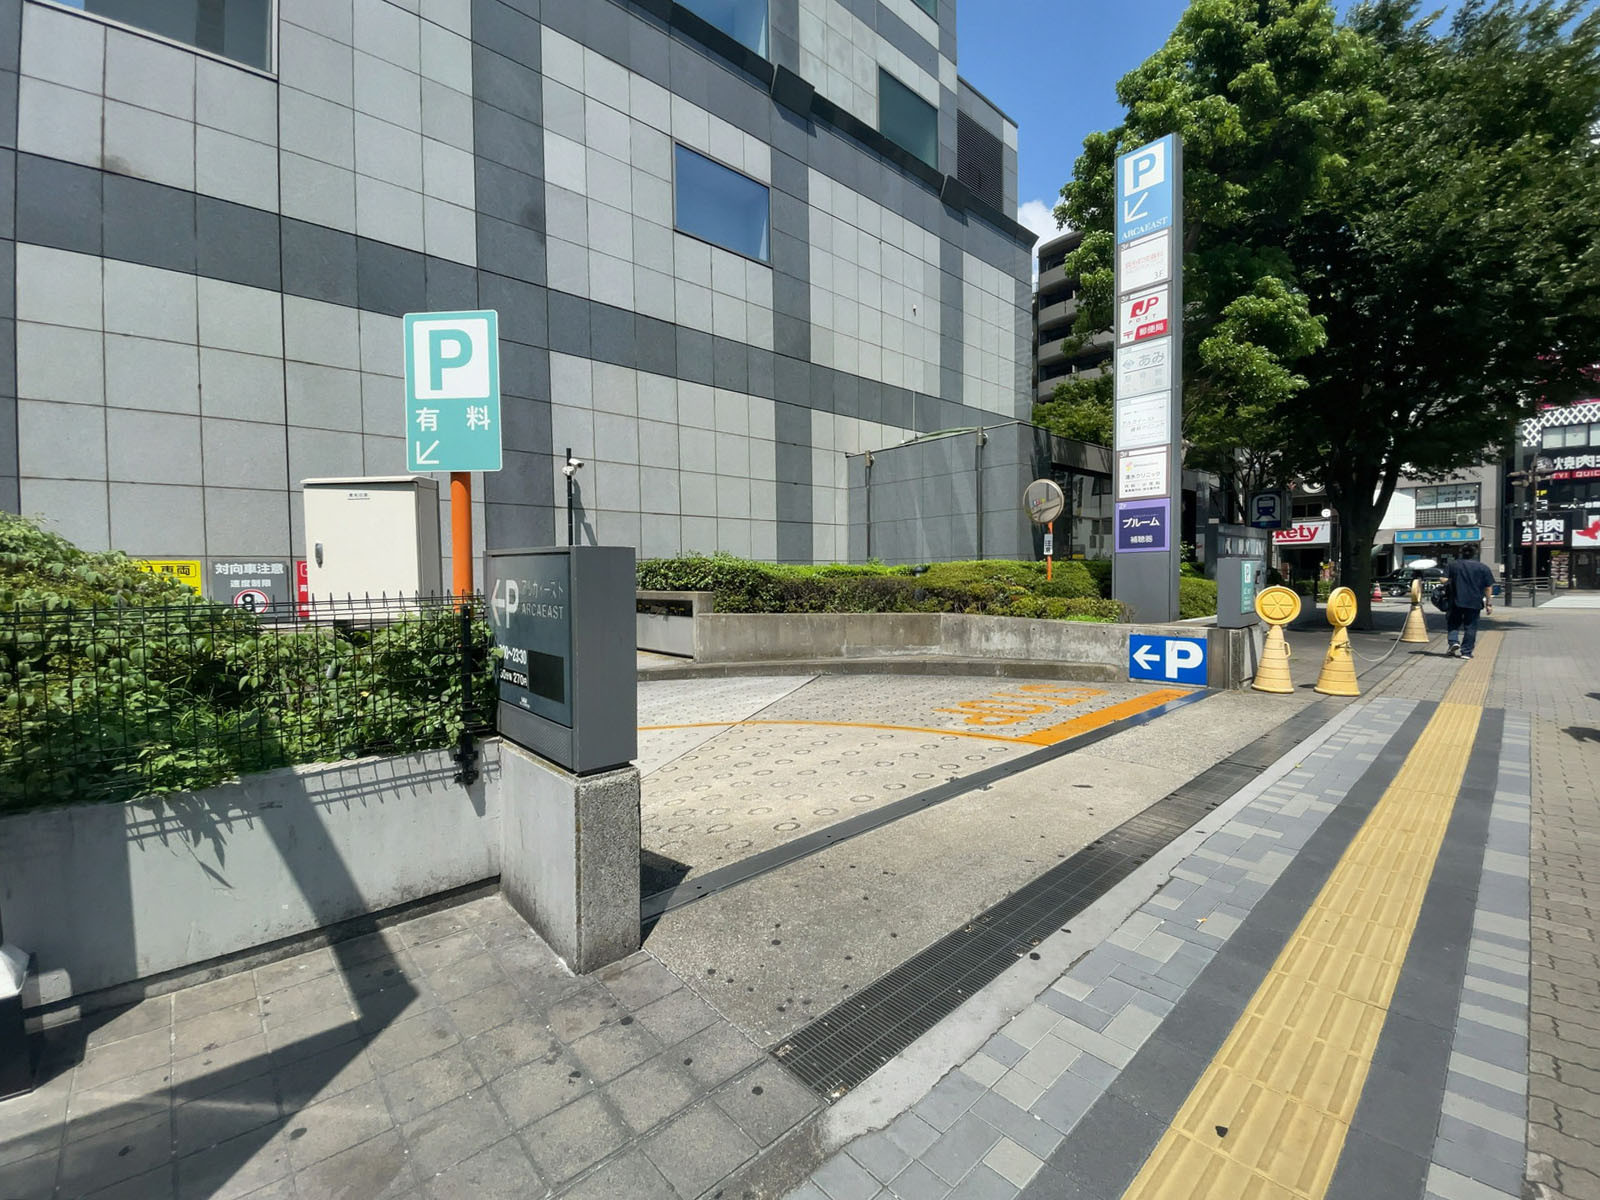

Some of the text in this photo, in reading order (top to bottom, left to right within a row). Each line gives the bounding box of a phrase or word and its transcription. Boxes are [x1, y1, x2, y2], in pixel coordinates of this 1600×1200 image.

[1132, 153, 1157, 190] P
[1122, 216, 1168, 240] ARCAEAST
[1130, 296, 1159, 319] JP
[1128, 313, 1157, 325] POST
[428, 328, 473, 391] P
[1553, 454, 1600, 470] 焼肉
[1122, 516, 1160, 529] ブルーム
[1273, 525, 1319, 541] kety
[214, 562, 284, 575] 対向車注意
[230, 578, 271, 588] 速度制限
[505, 579, 519, 629] P
[521, 602, 564, 620] ARCAEAST
[1165, 639, 1204, 679] P
[932, 684, 1109, 727] STOP
